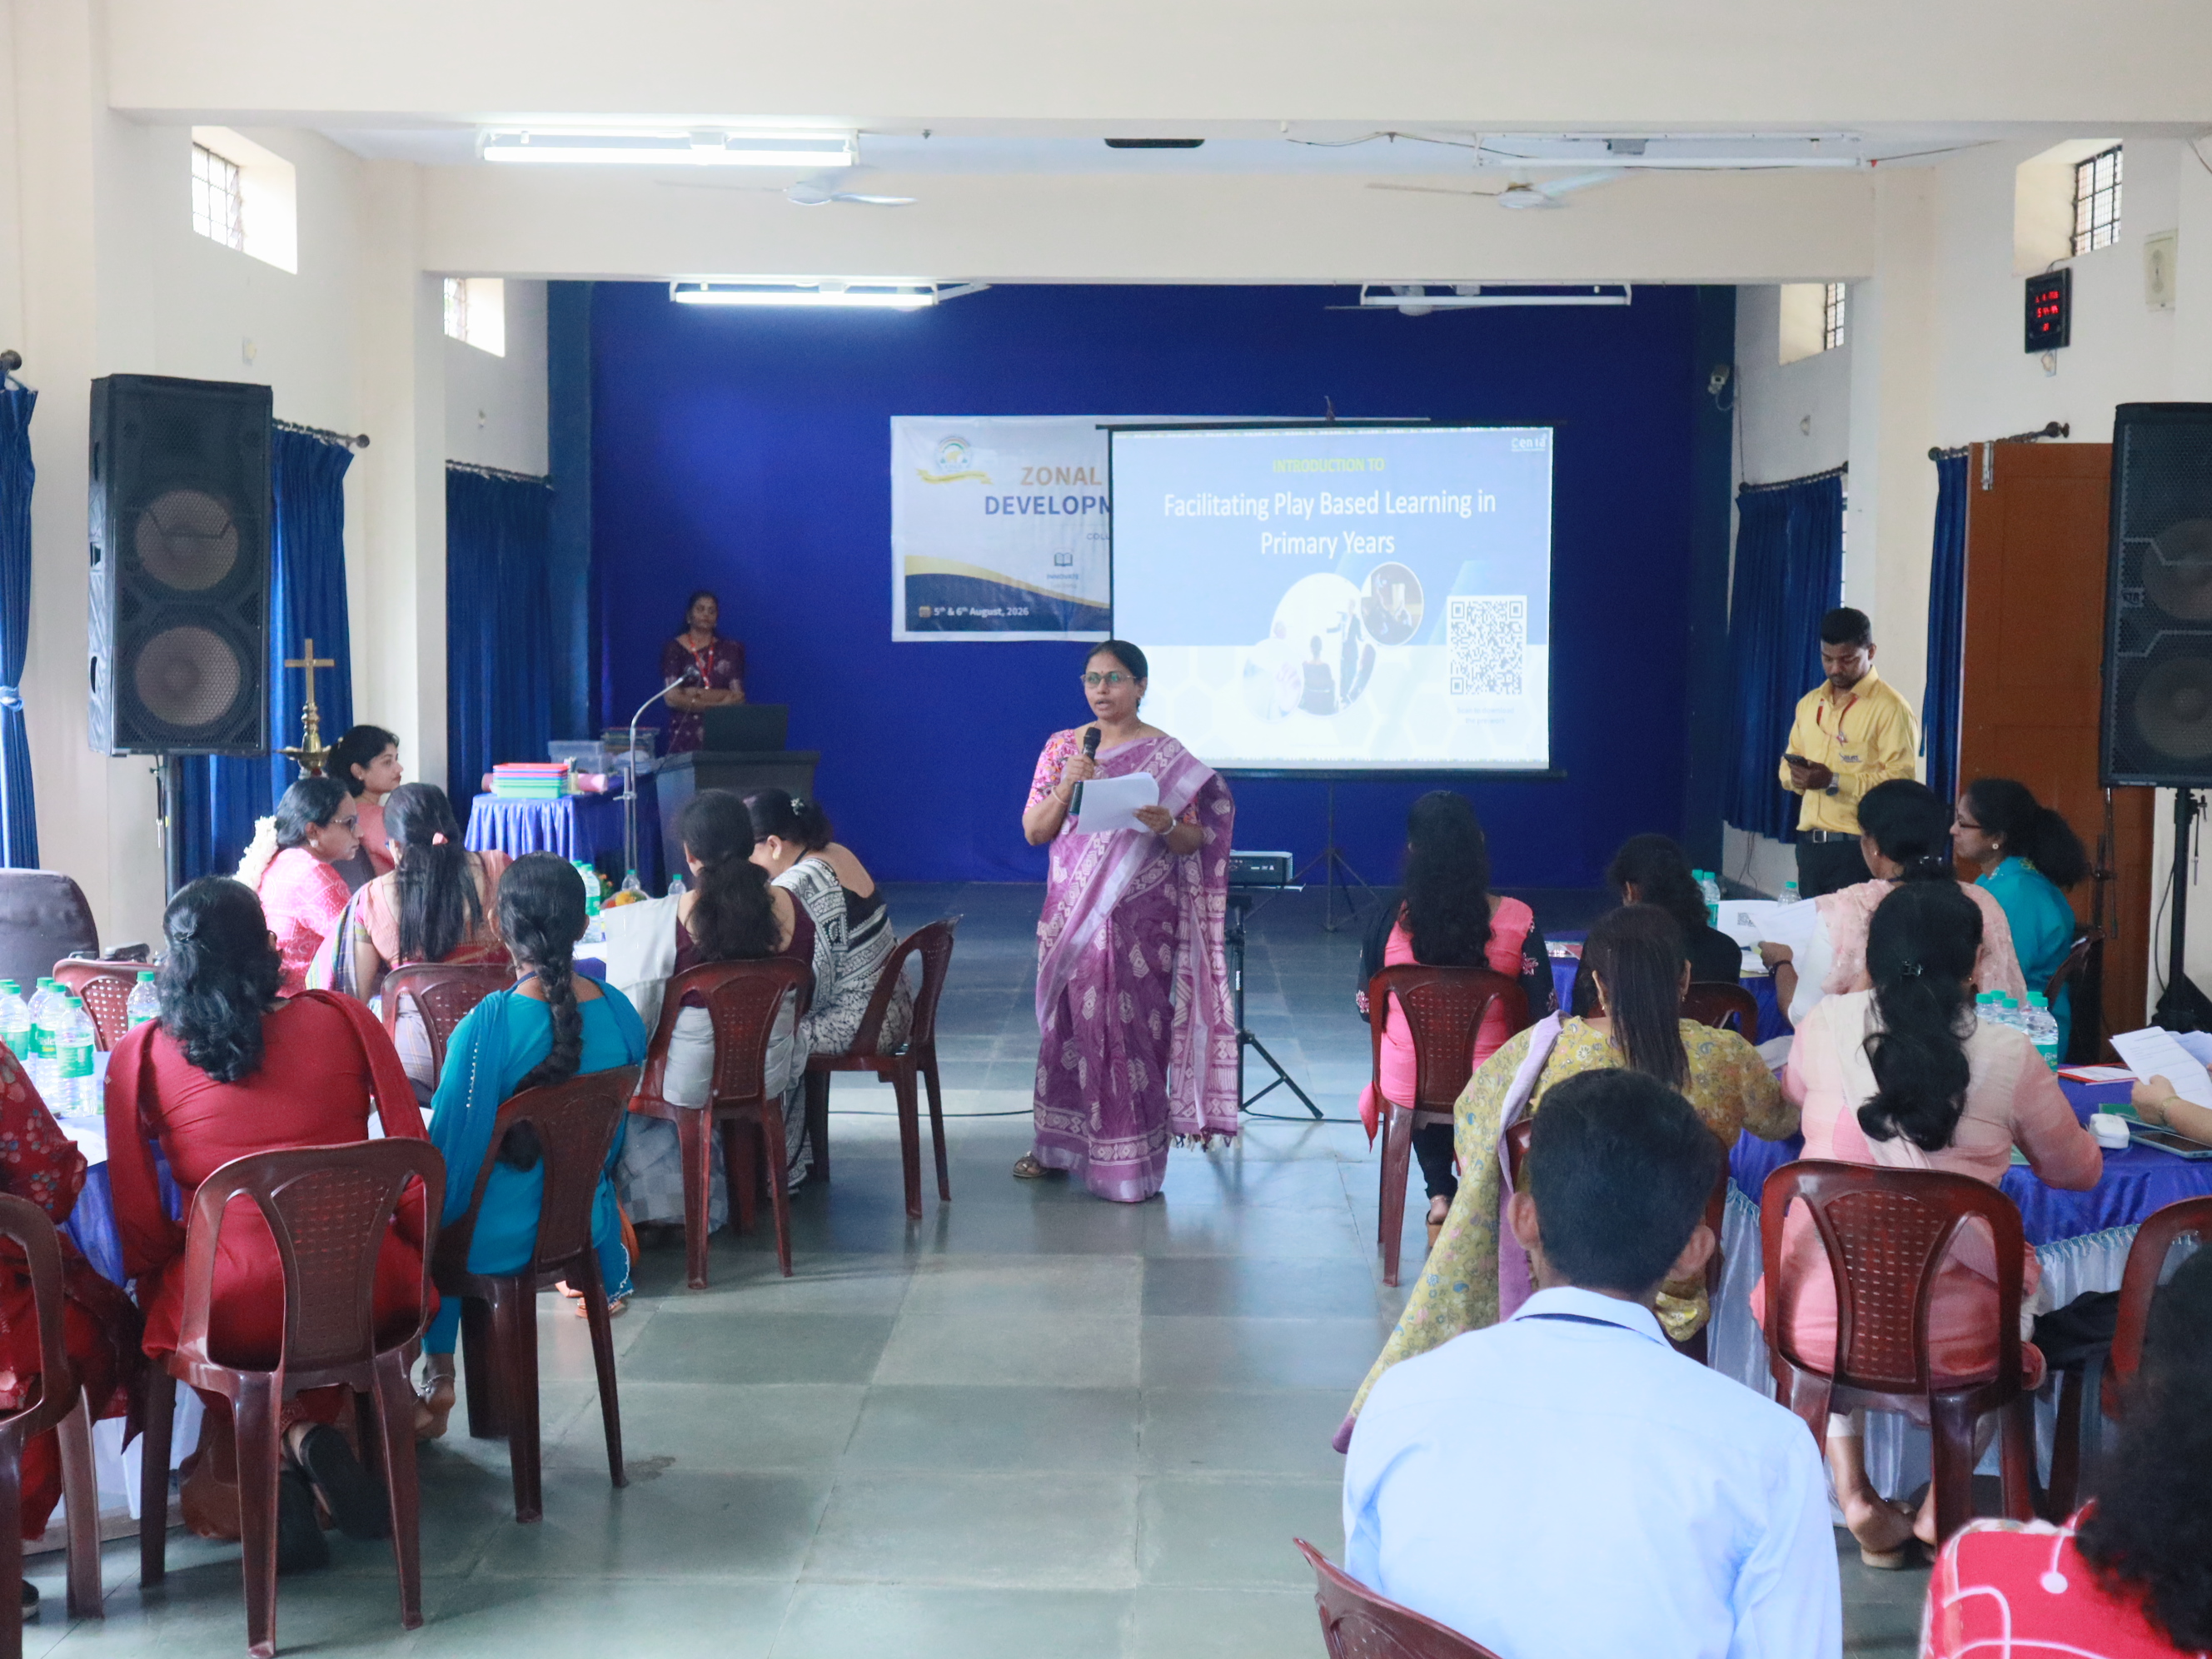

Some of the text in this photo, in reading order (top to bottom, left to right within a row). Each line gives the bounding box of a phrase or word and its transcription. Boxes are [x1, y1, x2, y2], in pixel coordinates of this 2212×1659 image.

[1273, 457, 1385, 472] INTRODUCTION TO
[1020, 466, 1103, 486] ZONAL
[1164, 489, 1496, 521] Facilitating Play Based Learning in
[1261, 531, 1395, 559] Primary Years
[947, 606, 955, 616] &
[969, 606, 1005, 619] August,
[1006, 606, 1029, 616] 2026
